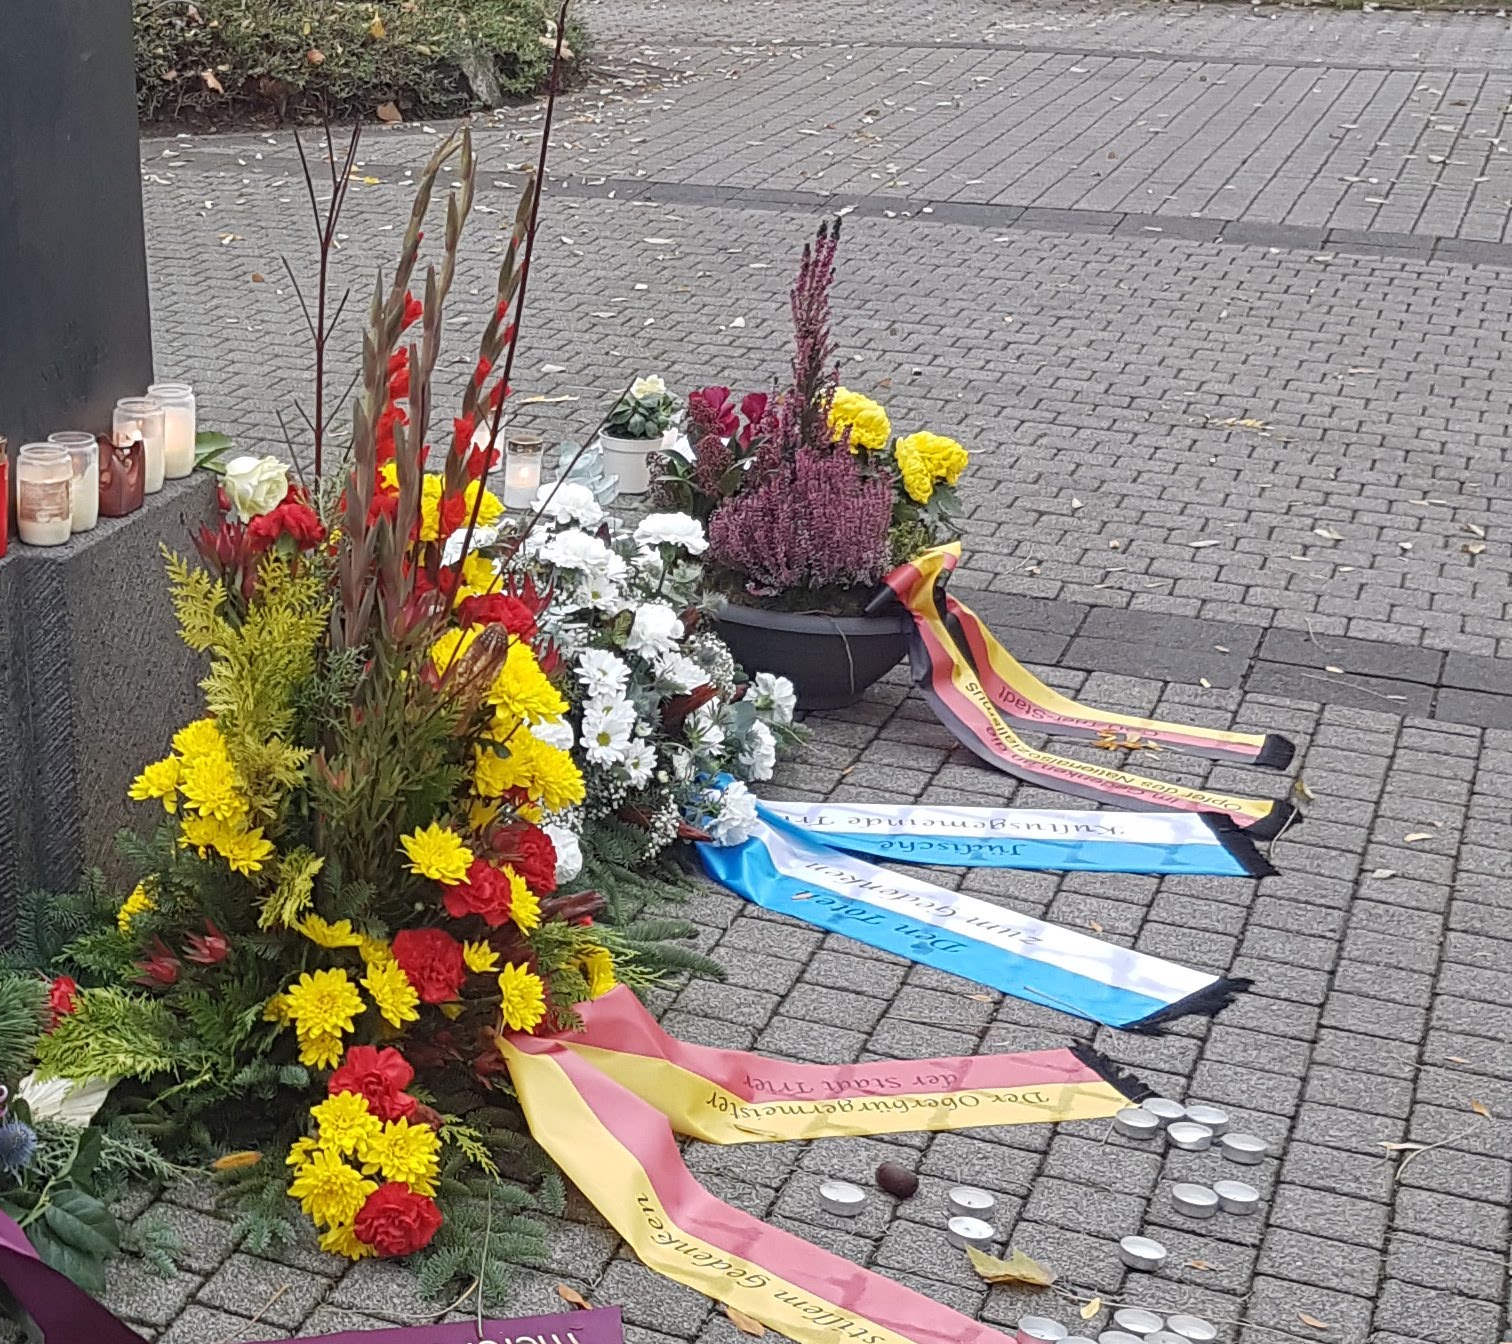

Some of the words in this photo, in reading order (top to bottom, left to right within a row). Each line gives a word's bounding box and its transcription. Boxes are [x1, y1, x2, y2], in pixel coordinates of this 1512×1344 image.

[964, 681, 1136, 784] Nationalsozialismus
[1140, 779, 1179, 796] des
[1183, 791, 1244, 813] Opfer
[846, 816, 1125, 836] Kultusgemeinde
[879, 838, 1028, 857] Jüdische
[802, 862, 960, 919] Gedenken
[898, 923, 971, 954] Den
[742, 1074, 814, 1095] Trier
[820, 1076, 903, 1091] Stadt
[912, 1073, 959, 1090] der
[705, 1090, 982, 1120] Oberbürgermeister
[991, 1091, 1051, 1105] Der
[633, 1191, 772, 1291] Gedenken
